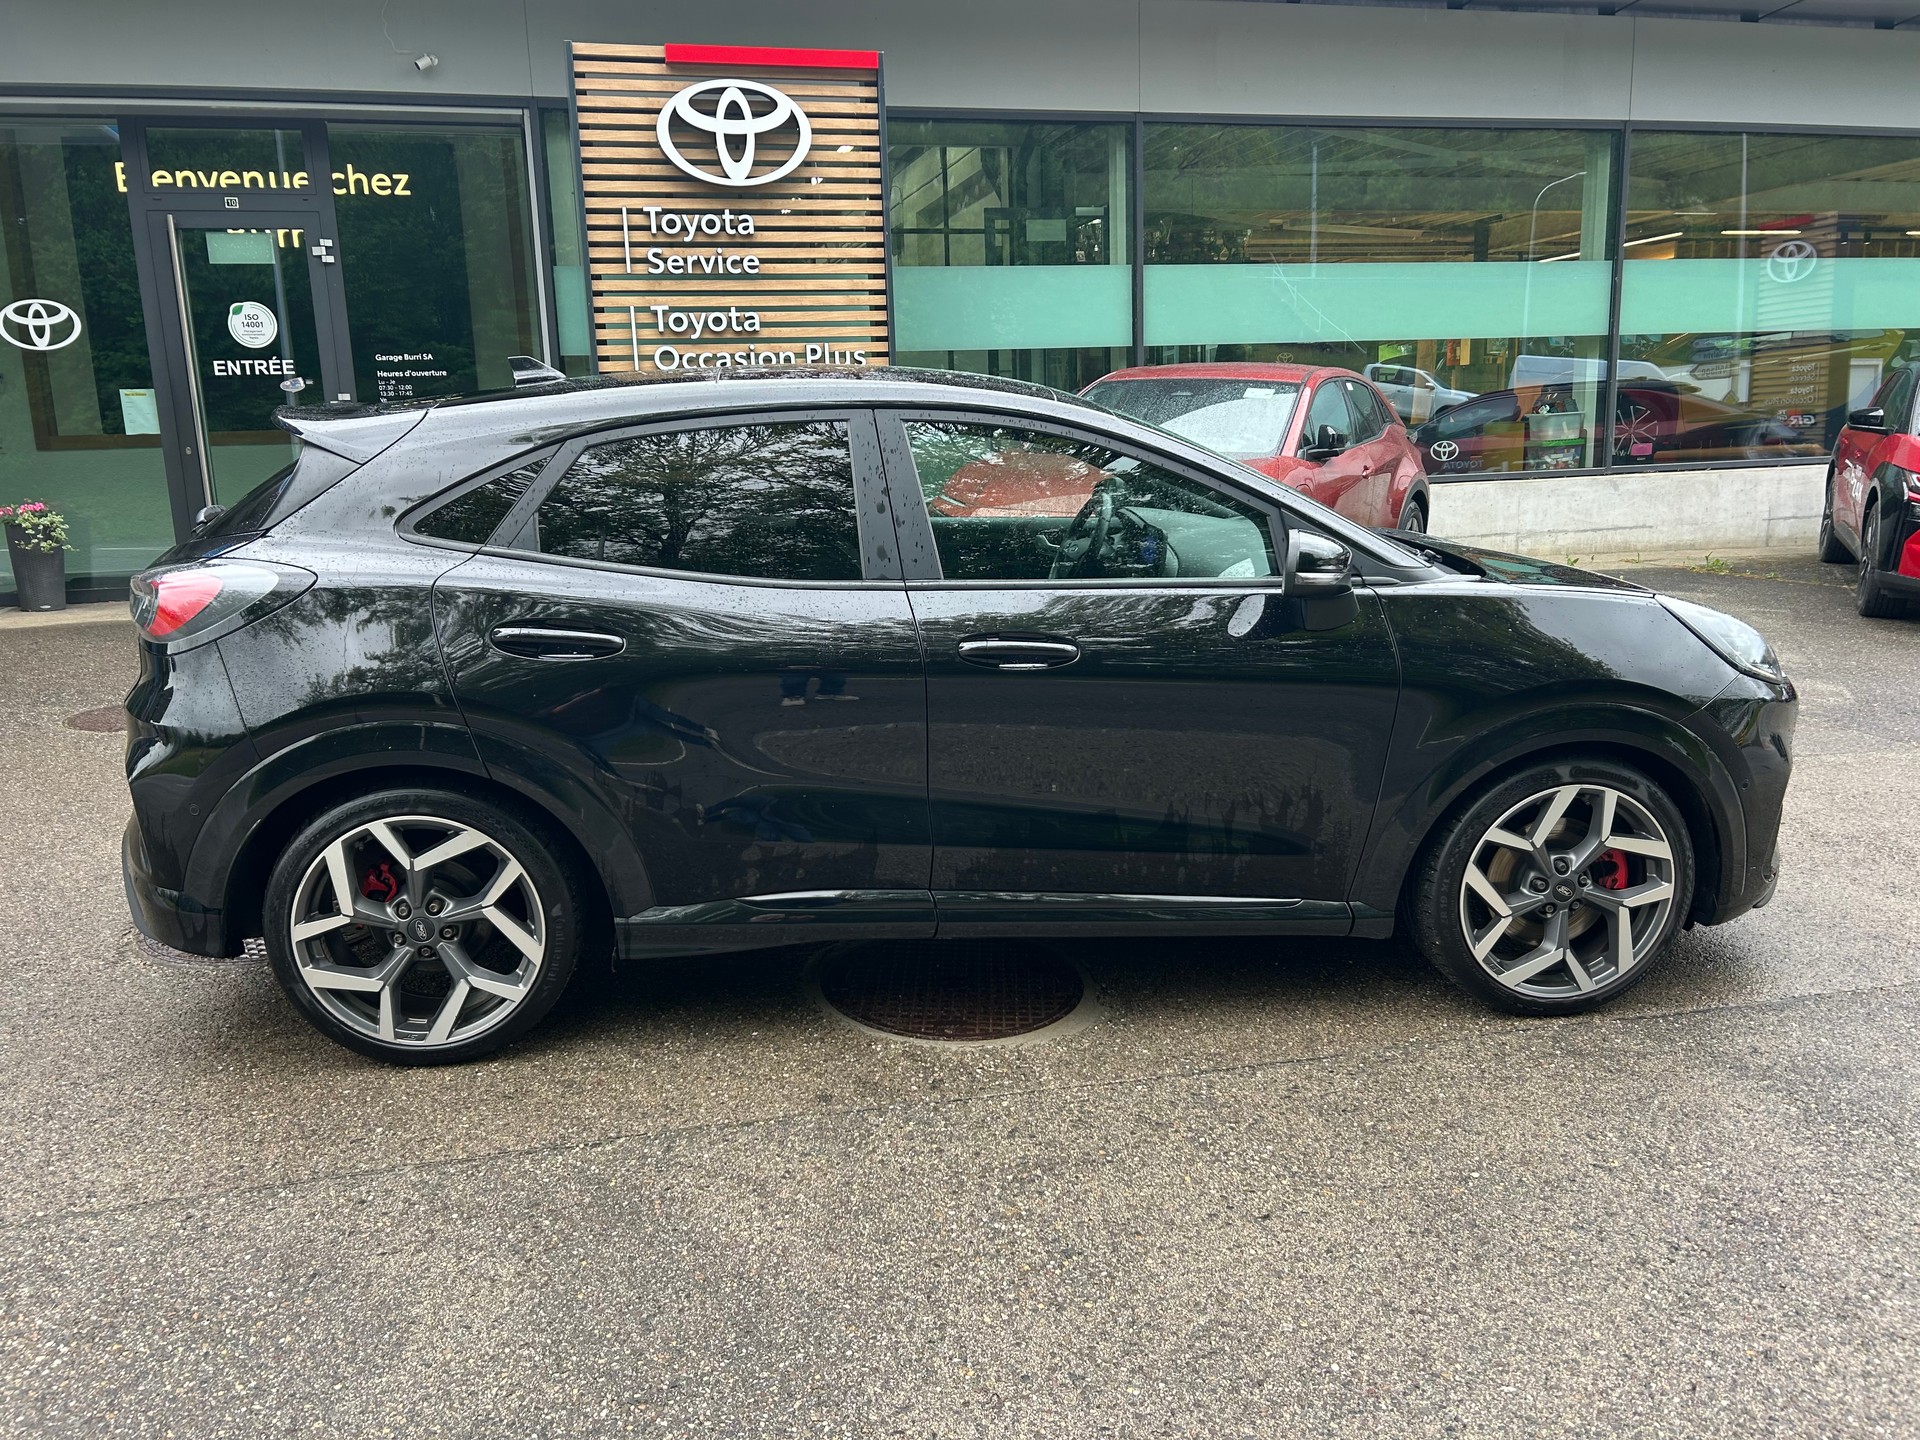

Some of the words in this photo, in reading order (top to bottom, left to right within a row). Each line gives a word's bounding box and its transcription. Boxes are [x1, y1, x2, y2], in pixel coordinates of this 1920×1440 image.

[331, 163, 412, 195] chez
[642, 206, 755, 242] Toyota
[647, 247, 760, 275] Service
[244, 313, 259, 321] ISO
[650, 305, 761, 339] Toyota
[212, 355, 296, 376] ENTRÉE
[375, 353, 403, 363] Garage
[403, 353, 422, 361] Burri
[422, 353, 434, 361] SA
[653, 343, 796, 370] Occasion
[804, 342, 867, 366] Plus
[404, 369, 448, 377] d'ouverture
